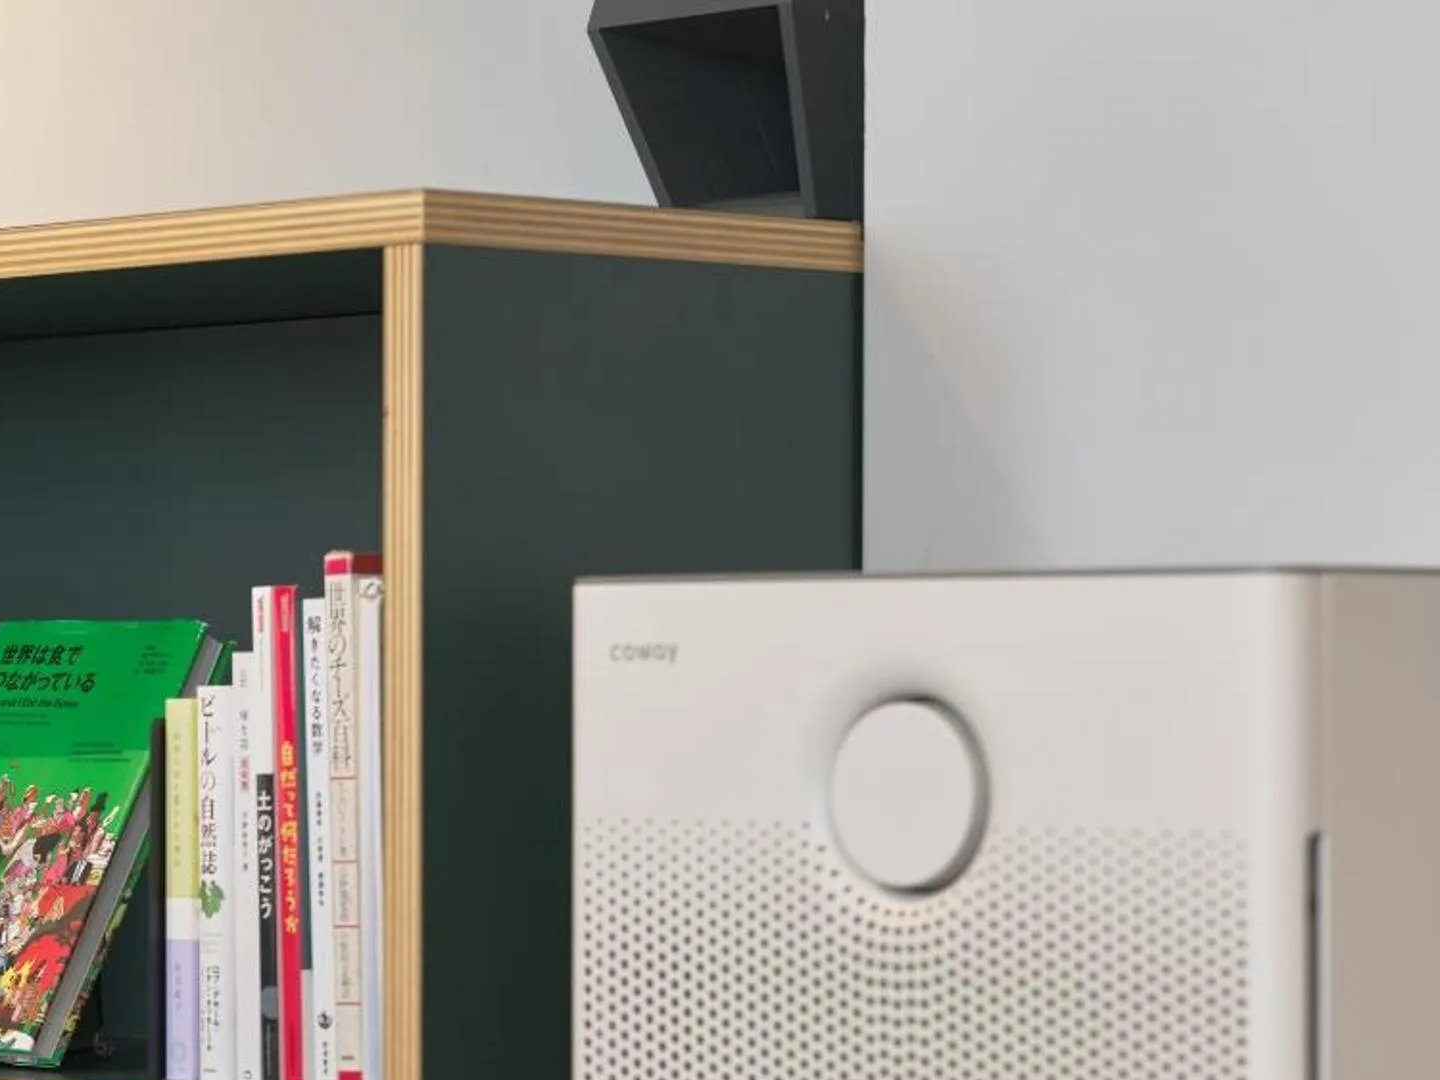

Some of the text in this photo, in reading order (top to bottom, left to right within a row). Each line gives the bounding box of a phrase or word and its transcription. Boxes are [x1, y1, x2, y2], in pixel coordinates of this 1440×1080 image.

[0, 643, 84, 666] 世界は食で
[201, 695, 217, 876] ビールの自然誌
